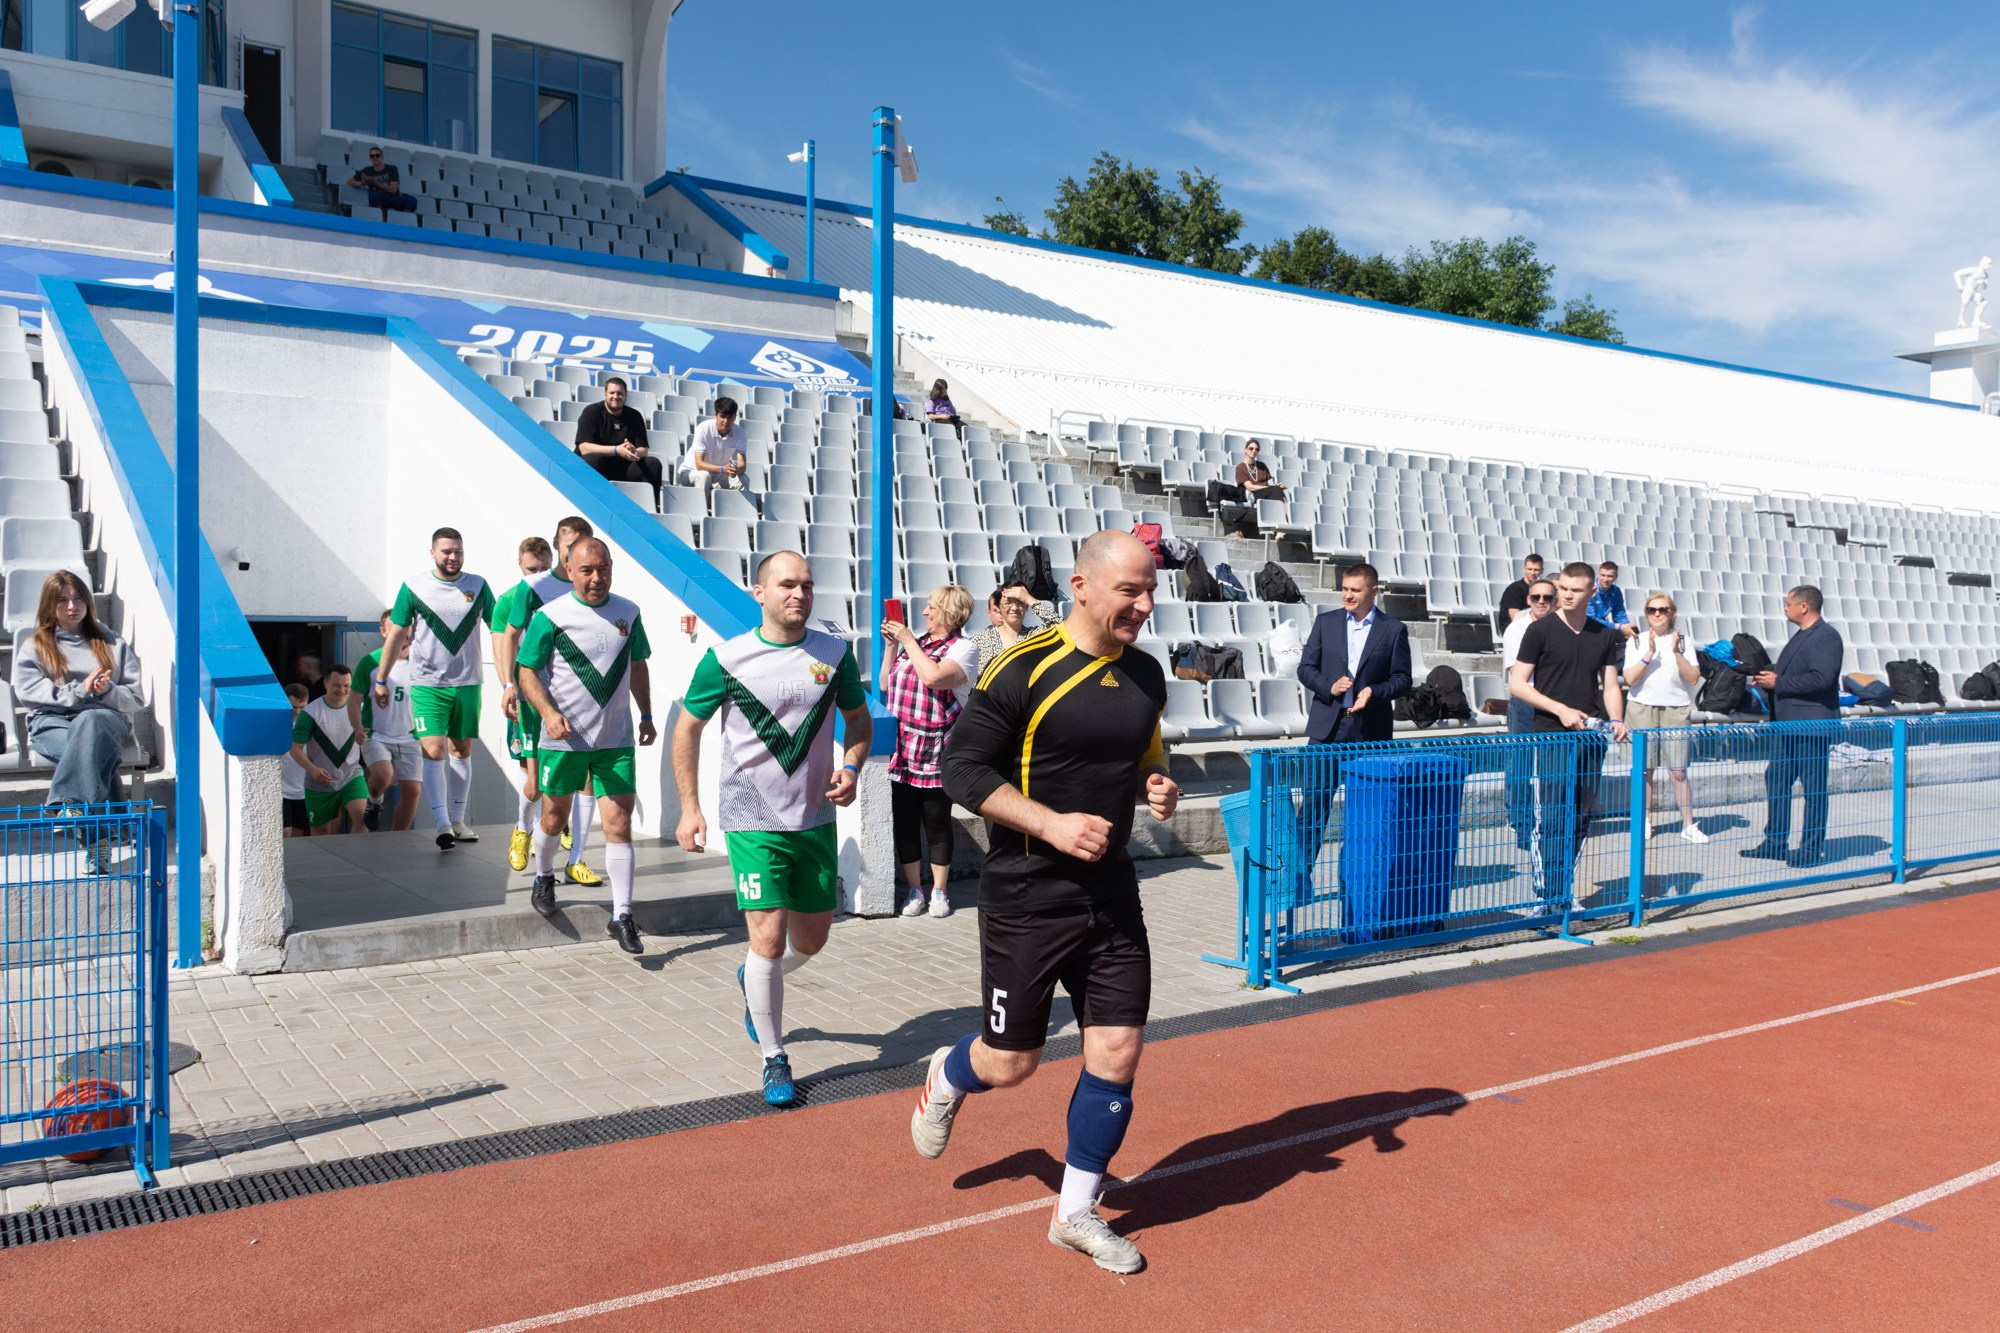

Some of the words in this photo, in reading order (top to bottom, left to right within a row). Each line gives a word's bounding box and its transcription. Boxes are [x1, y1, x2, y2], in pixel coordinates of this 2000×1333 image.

[456, 324, 655, 374] 2025
[596, 632, 608, 653] 3
[394, 686, 405, 702] 5
[777, 680, 806, 706] 45
[542, 765, 551, 787] 3
[739, 872, 762, 900] 45
[990, 987, 1008, 1034] 5
